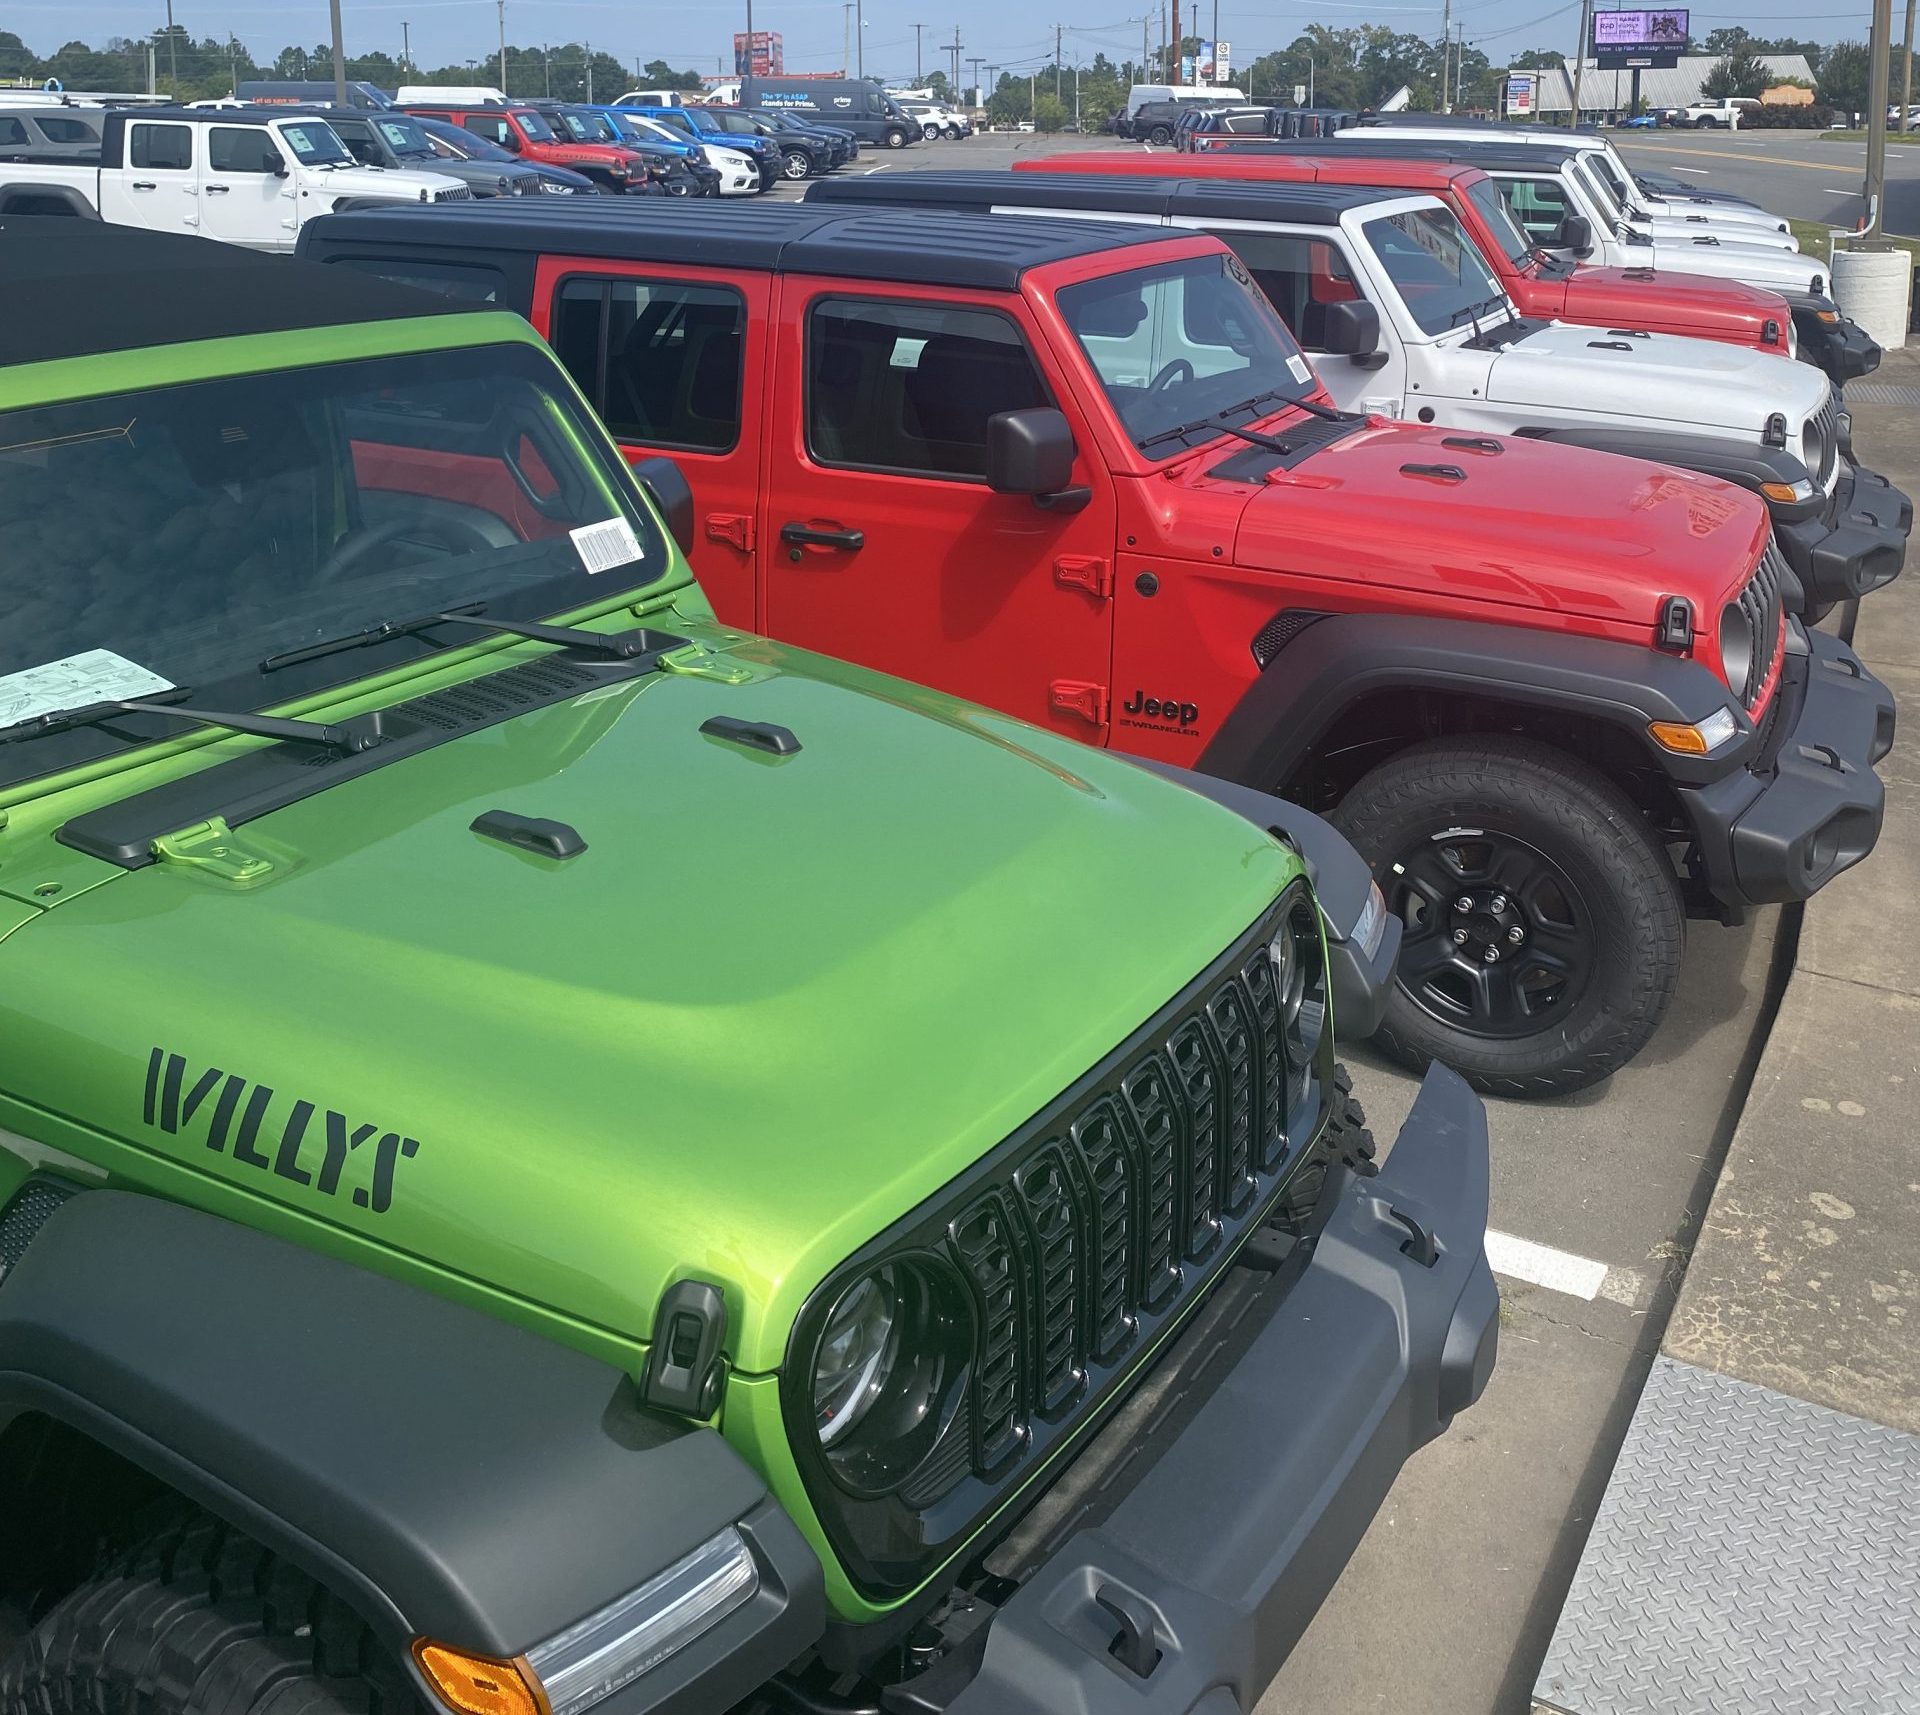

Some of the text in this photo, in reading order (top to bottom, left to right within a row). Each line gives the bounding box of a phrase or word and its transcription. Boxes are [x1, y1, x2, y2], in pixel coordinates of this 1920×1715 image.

[1123, 690, 1199, 727] Jeep
[1131, 720, 1200, 737] WRANGLER
[143, 1046, 421, 1214] WILLYS
